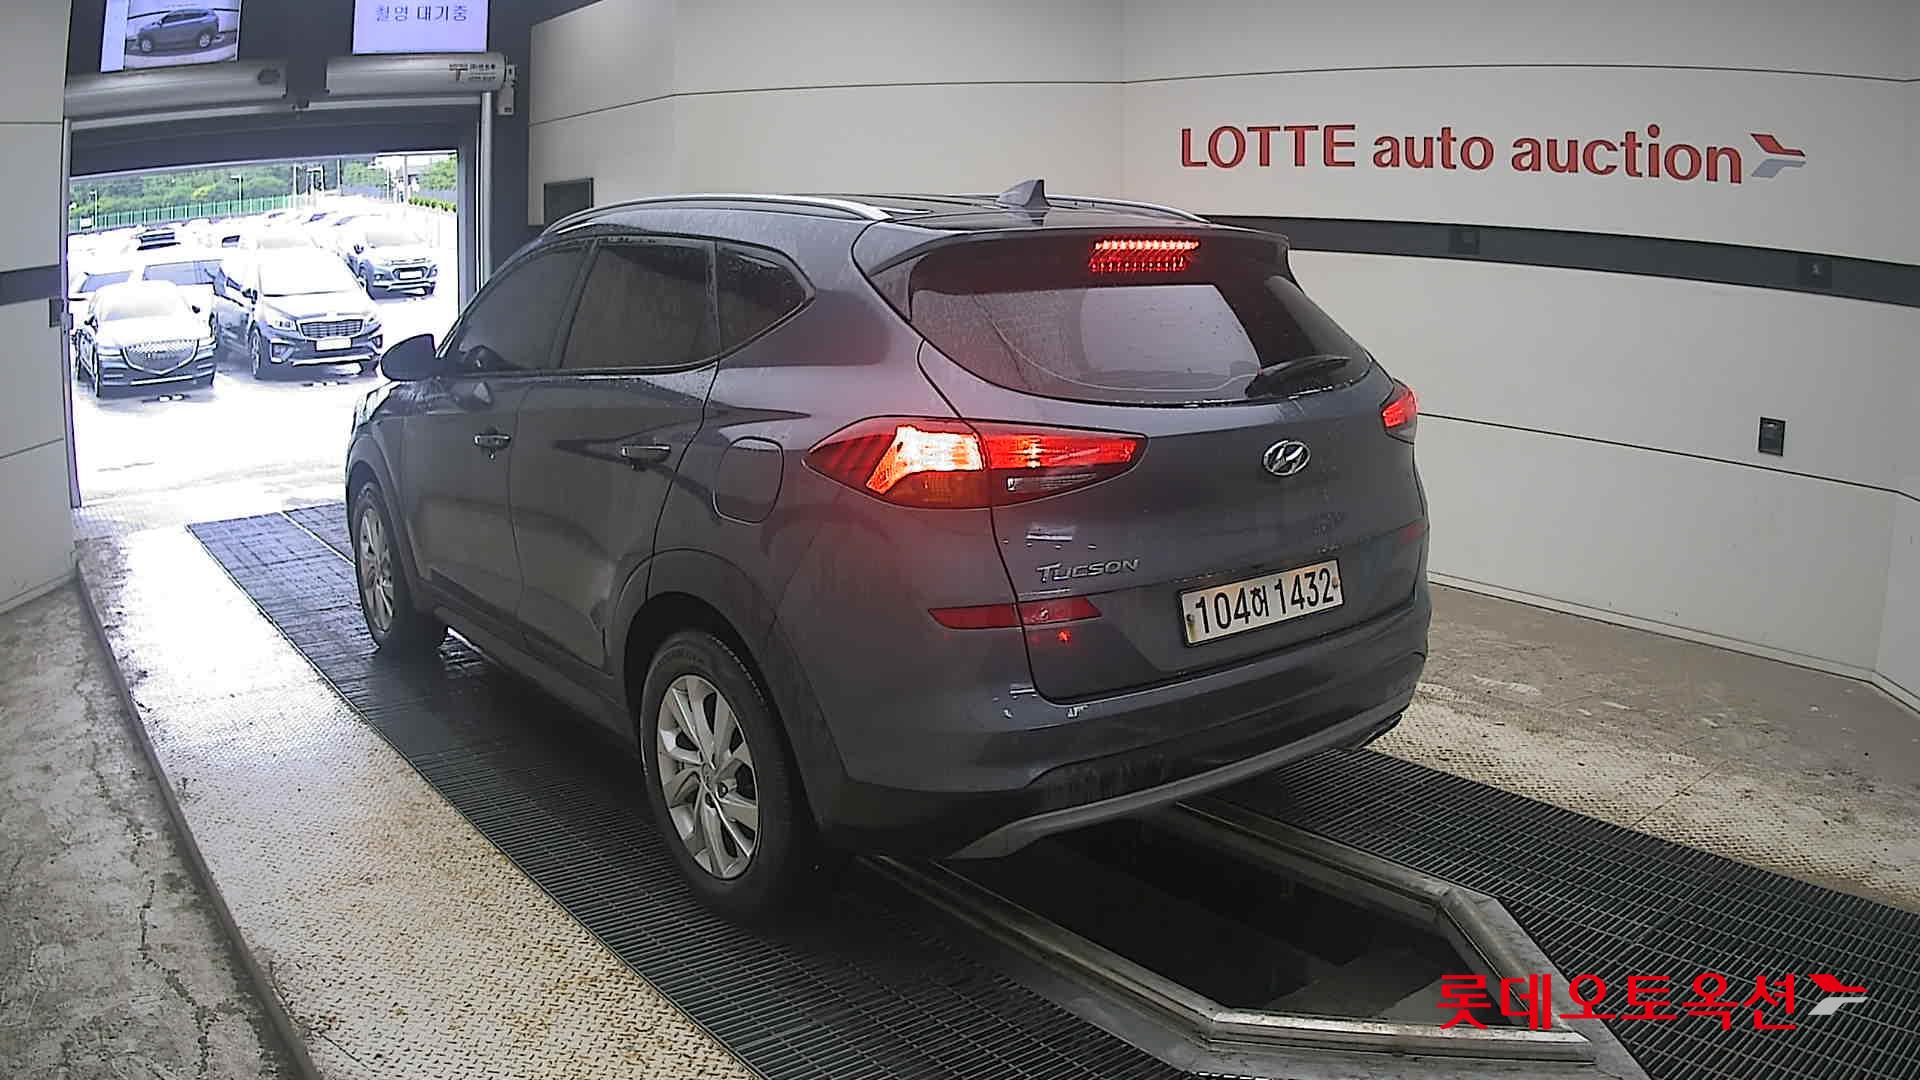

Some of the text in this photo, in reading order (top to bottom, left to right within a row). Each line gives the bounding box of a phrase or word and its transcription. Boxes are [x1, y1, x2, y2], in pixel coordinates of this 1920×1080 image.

[417, 5, 467, 22] 대기중
[1182, 123, 1742, 184] LOTTE auto auction
